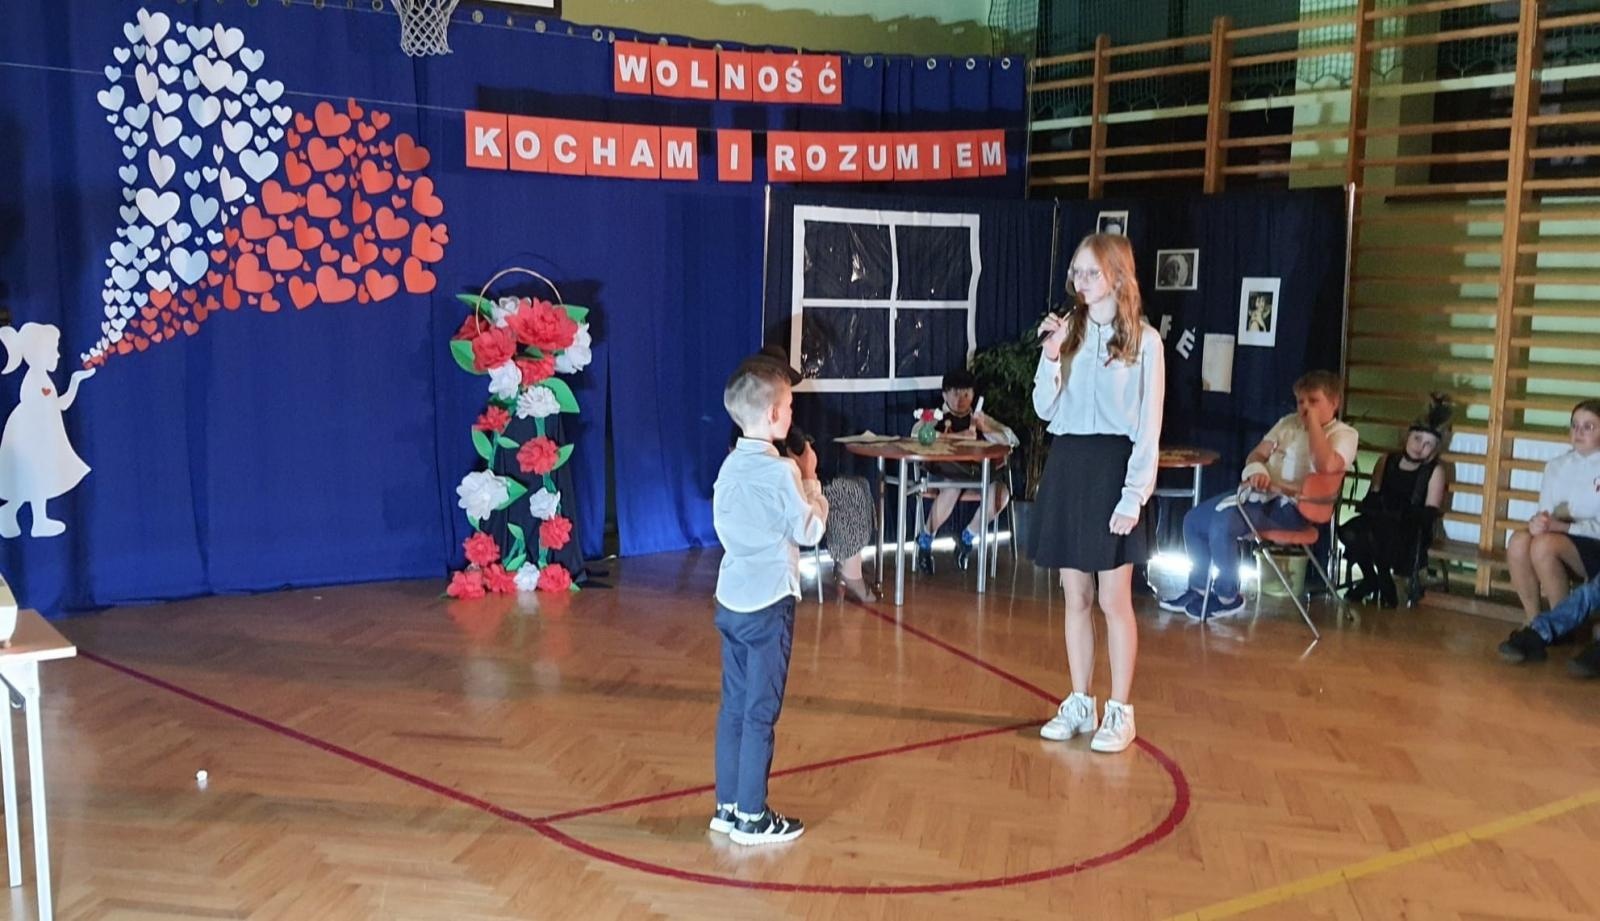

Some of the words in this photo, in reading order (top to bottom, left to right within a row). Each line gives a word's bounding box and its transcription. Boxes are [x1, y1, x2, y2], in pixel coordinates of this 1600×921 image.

[618, 54, 837, 94] WOLNOŚĆ
[475, 127, 692, 168] KOCHAM
[730, 143, 739, 171] I
[774, 142, 1001, 172] ROZUMIEM
